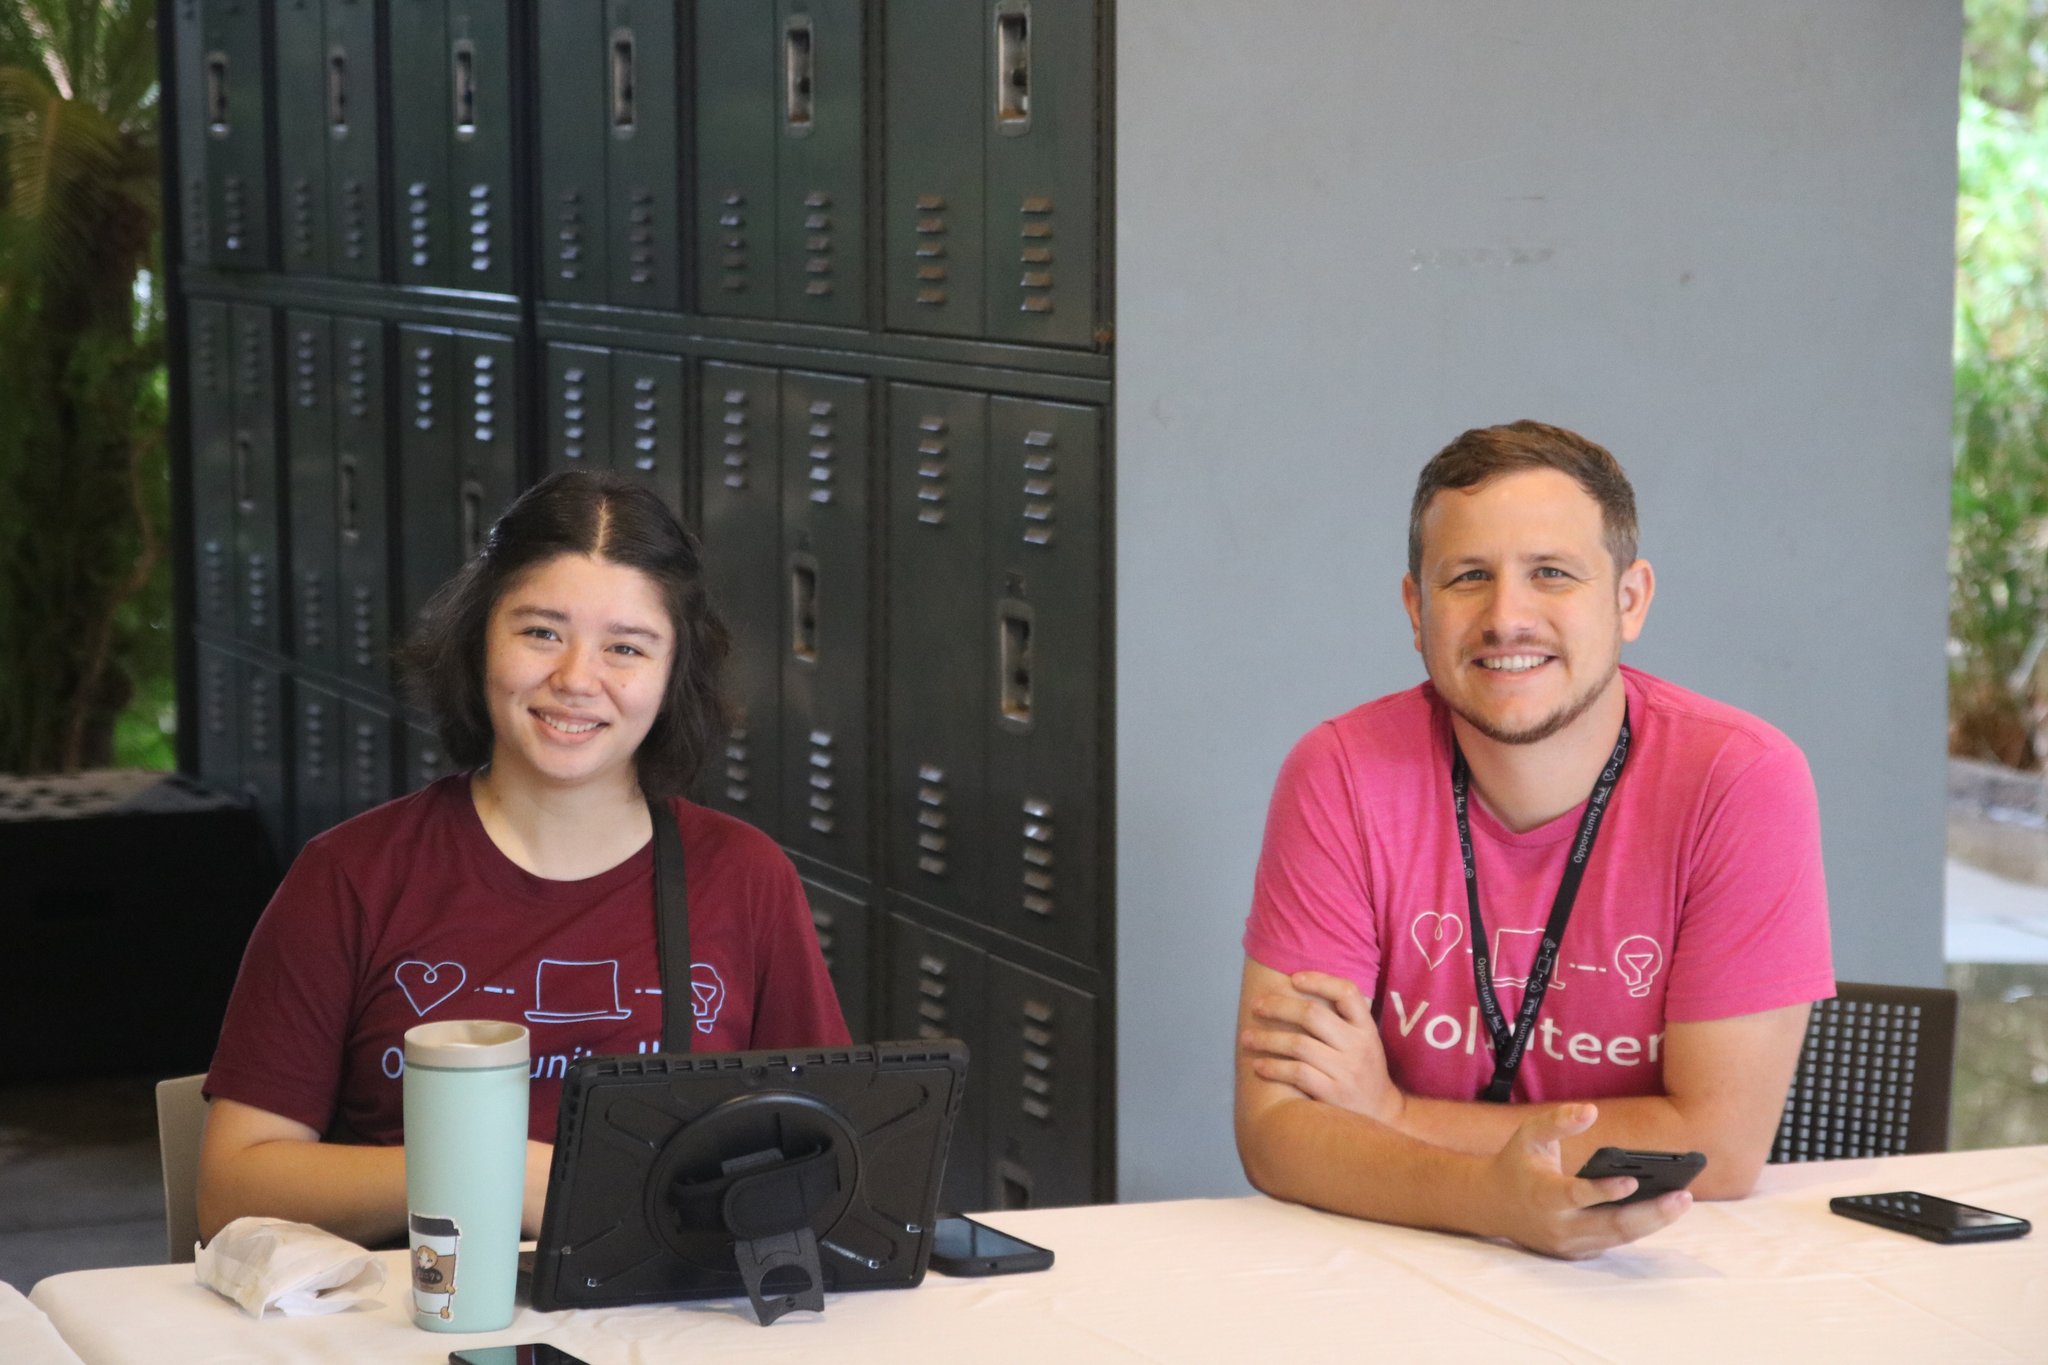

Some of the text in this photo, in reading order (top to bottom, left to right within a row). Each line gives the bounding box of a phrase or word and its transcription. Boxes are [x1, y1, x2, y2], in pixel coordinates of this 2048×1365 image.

[1573, 807, 1601, 864] Opportunity
[1477, 957, 1496, 1015] Opportunity
[1390, 991, 1665, 1067] Volteer
[1504, 1019, 1532, 1069] Opportunity
